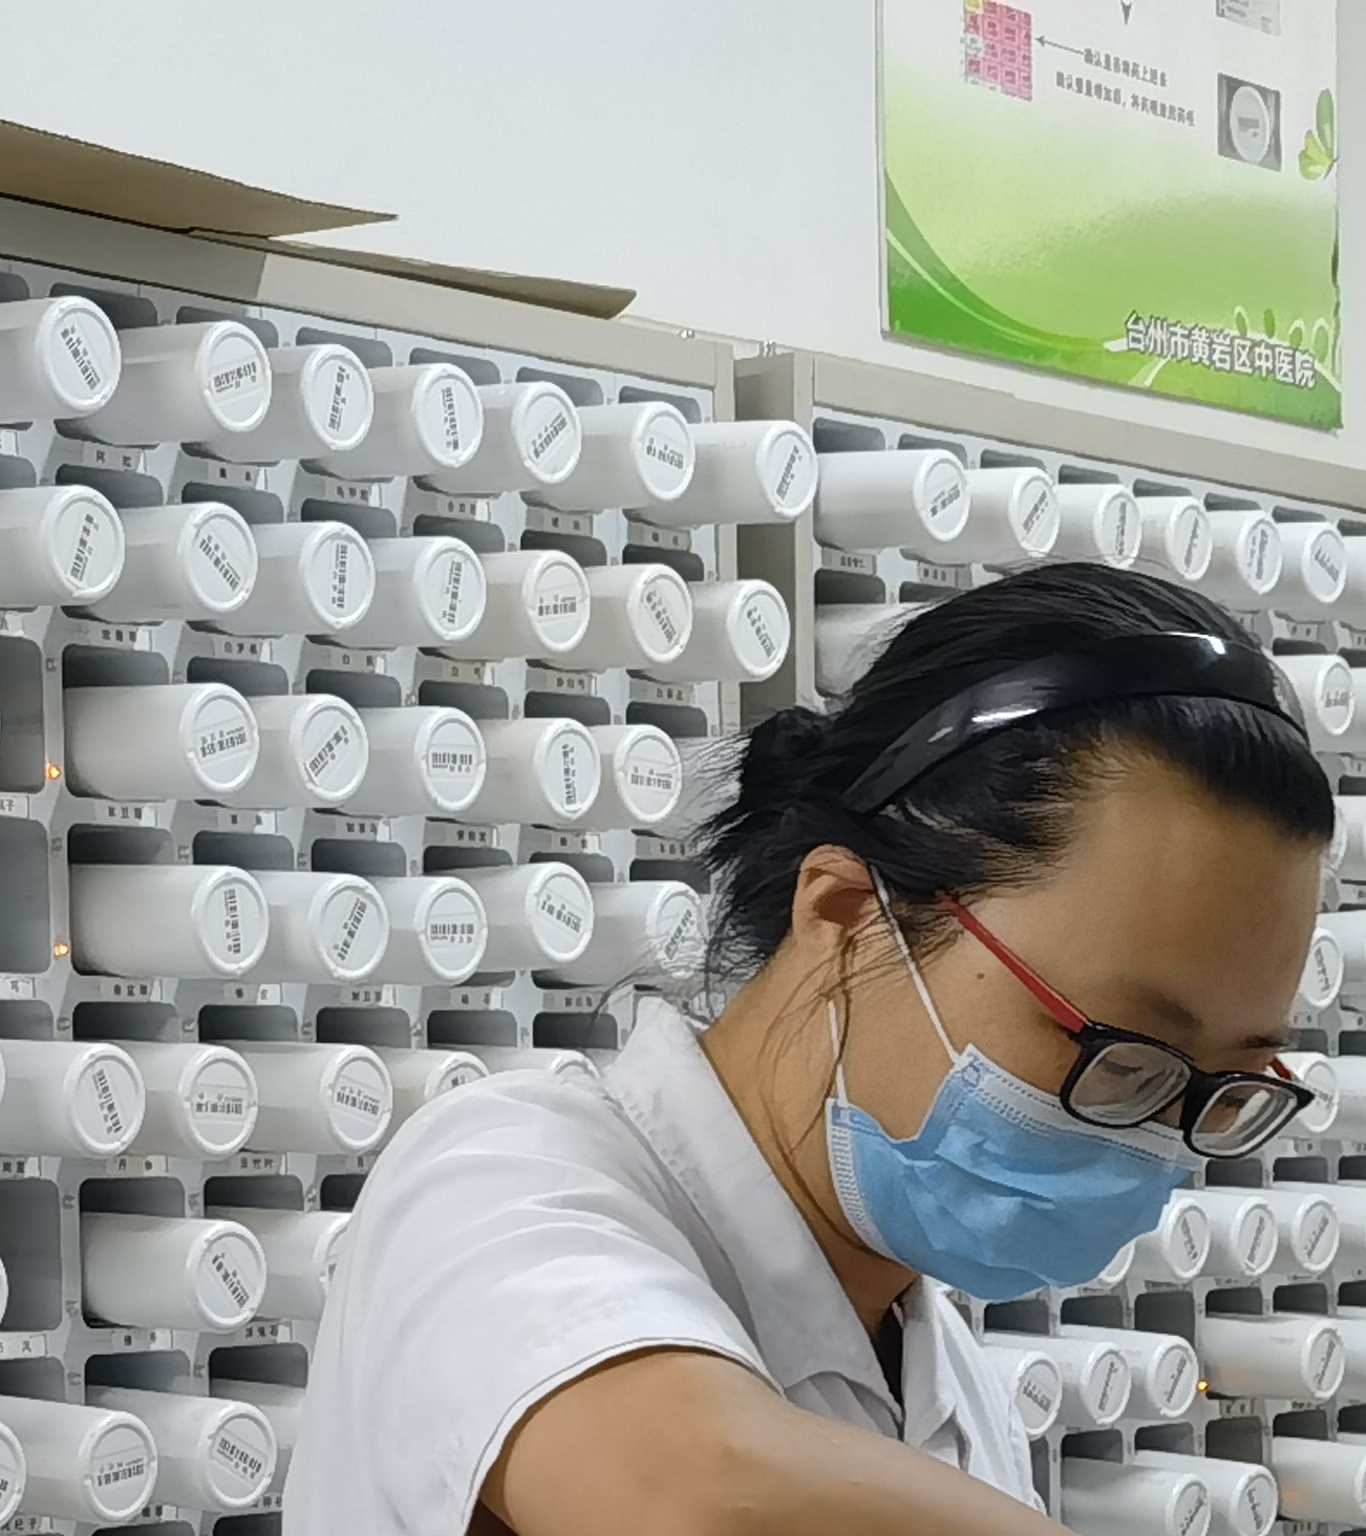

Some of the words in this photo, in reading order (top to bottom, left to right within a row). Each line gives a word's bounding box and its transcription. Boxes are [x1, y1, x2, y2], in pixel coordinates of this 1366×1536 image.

[1127, 312, 1316, 387] 台州市黄岩区中医院
